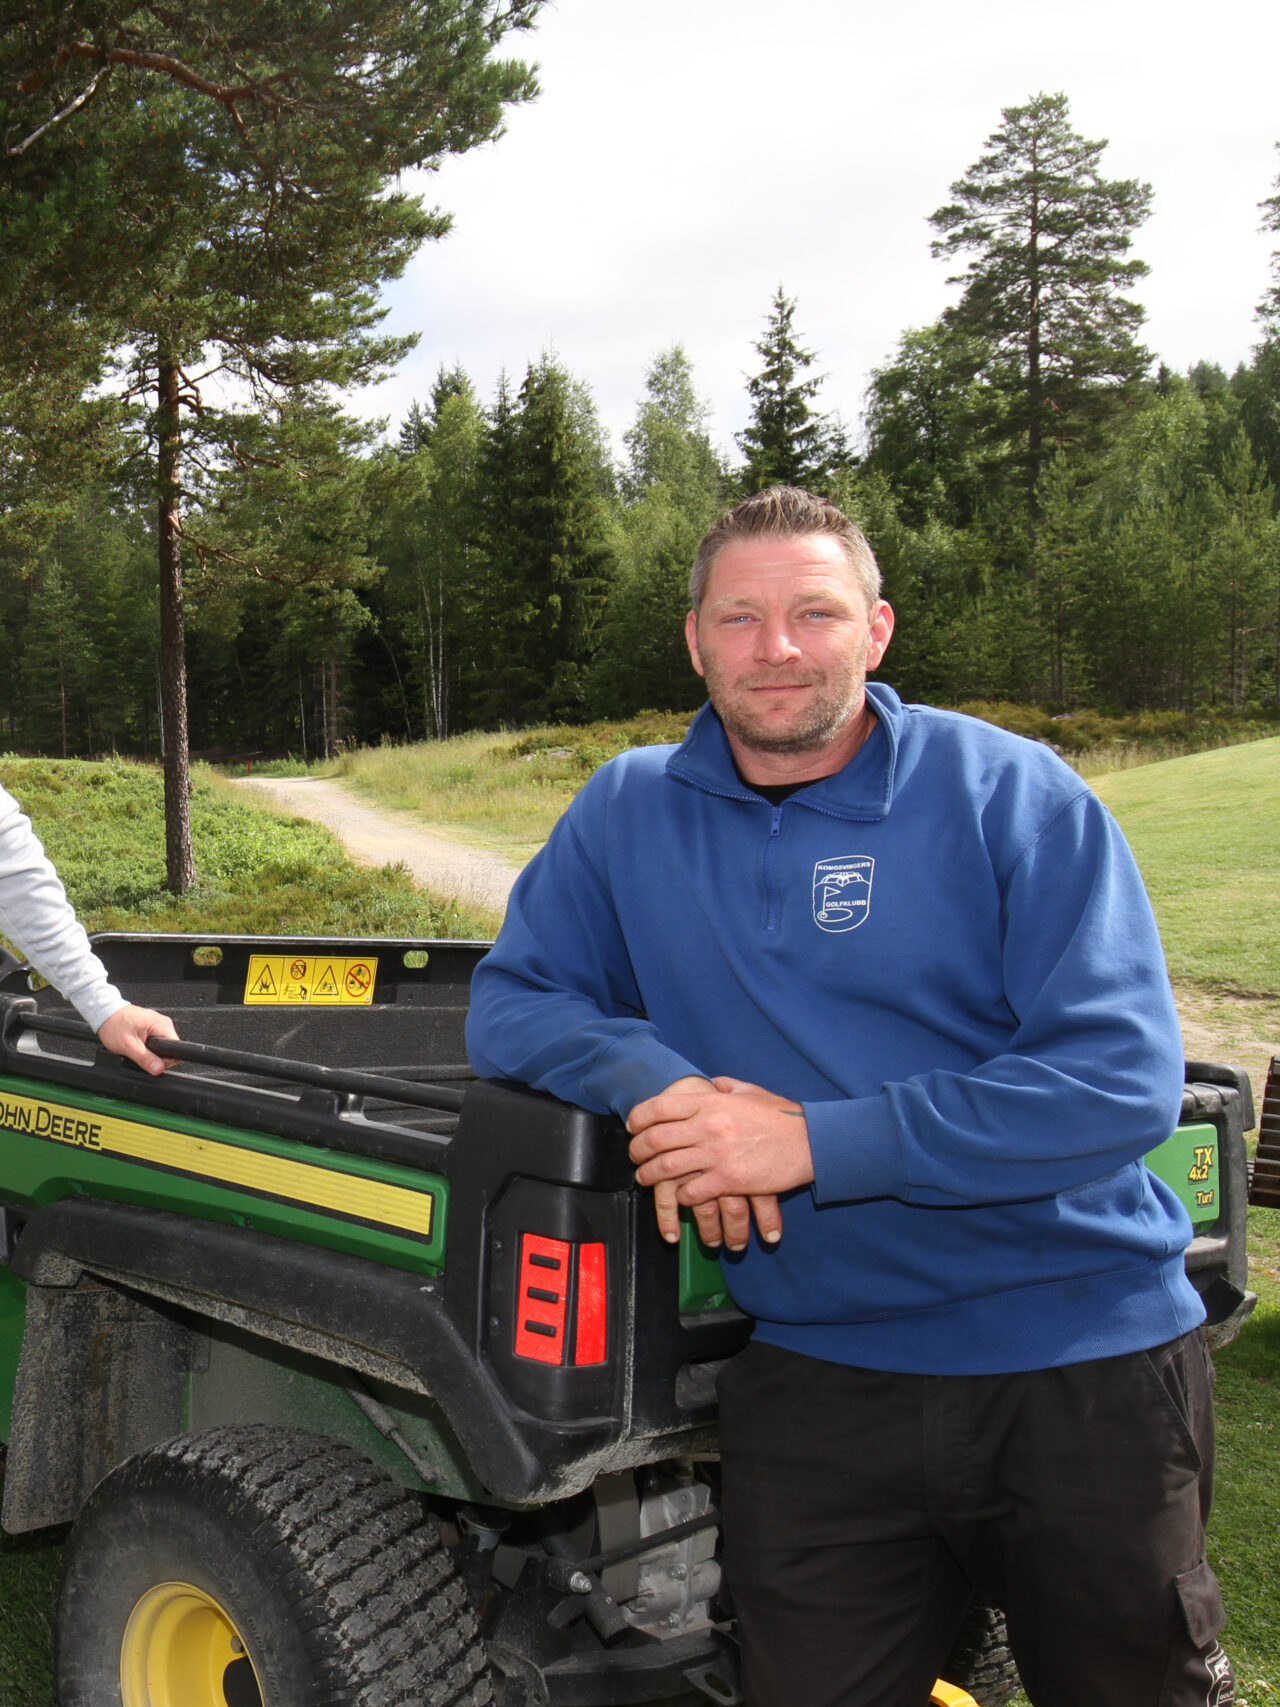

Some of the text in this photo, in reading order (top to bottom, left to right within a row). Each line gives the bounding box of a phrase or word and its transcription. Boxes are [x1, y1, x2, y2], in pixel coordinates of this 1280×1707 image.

[818, 862, 871, 871] KONGSVINGERS
[825, 900, 867, 908] GOLFKLUBB
[35, 1106, 102, 1147] DEERE
[1194, 1146, 1214, 1167] TX
[1189, 1165, 1209, 1181] 4x2
[1196, 1190, 1214, 1205] Turf
